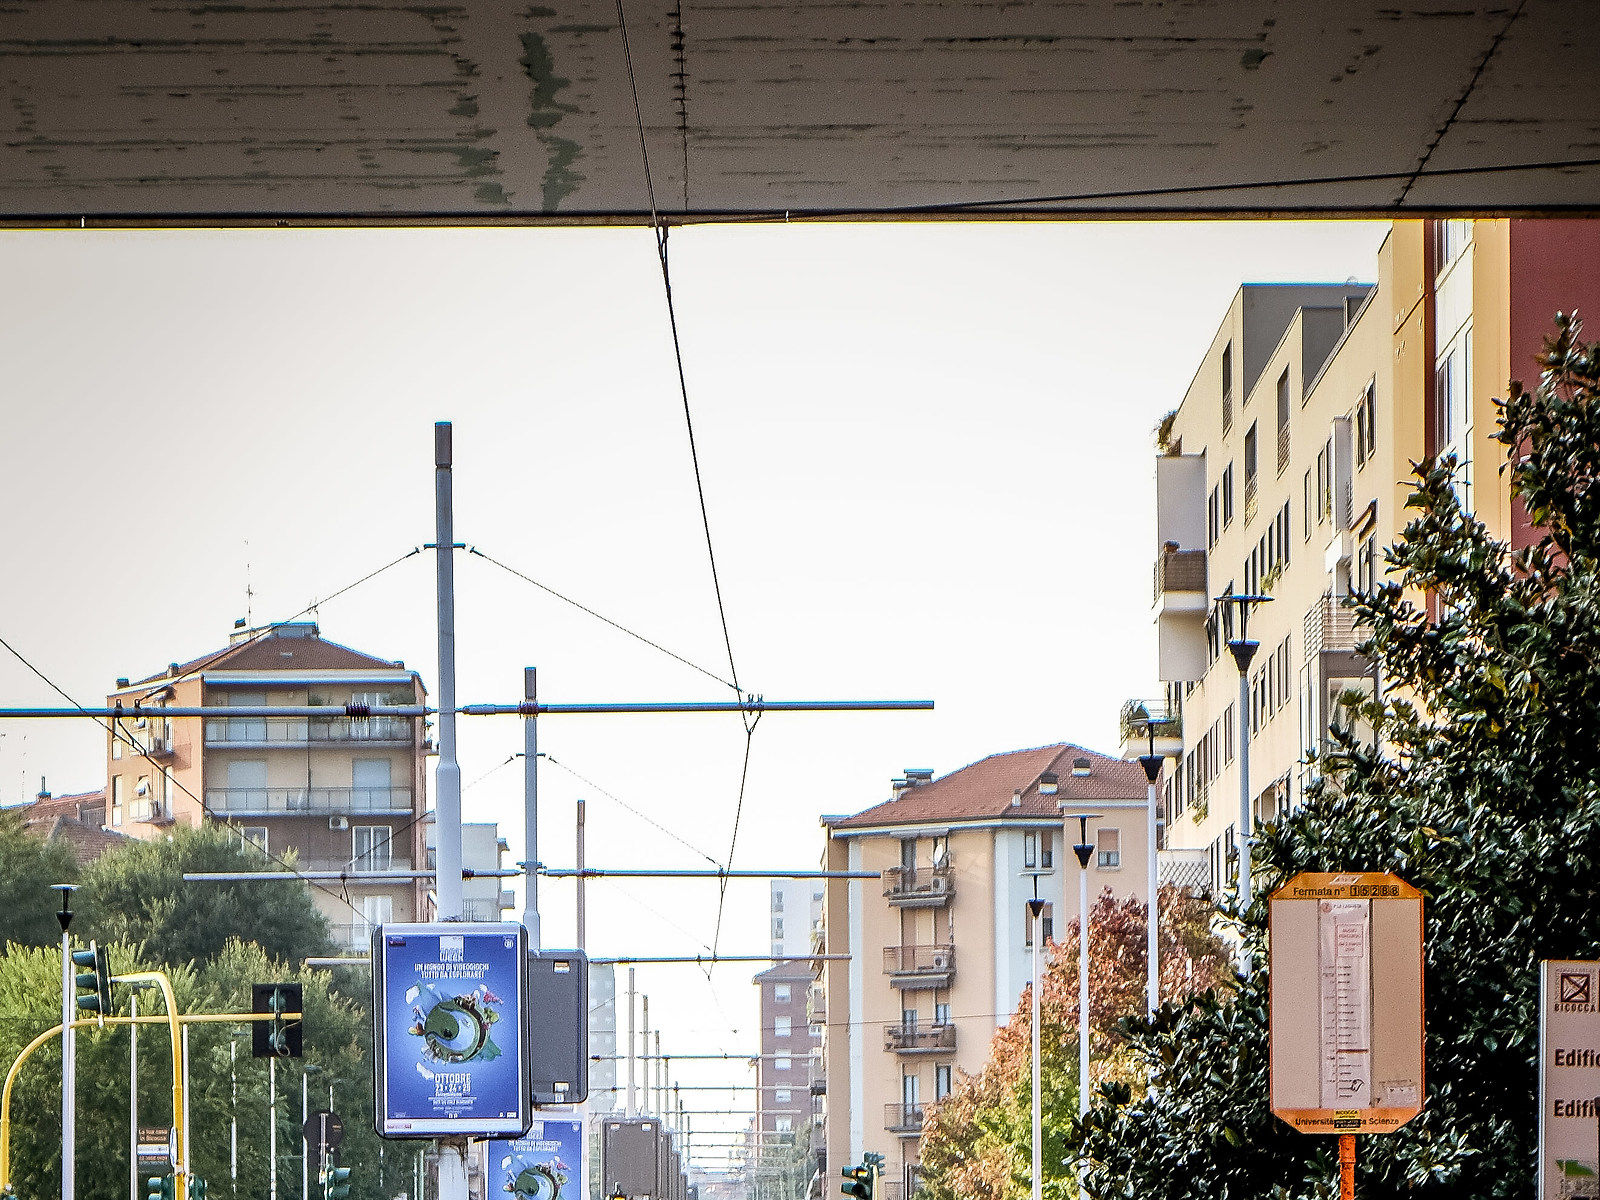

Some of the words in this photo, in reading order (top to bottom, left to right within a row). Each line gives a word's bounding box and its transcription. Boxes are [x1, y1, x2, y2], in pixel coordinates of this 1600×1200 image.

[1293, 887, 1332, 896] Fermata
[1554, 1003, 1596, 1012] BICOCCA
[435, 1073, 471, 1084] OTTOBRE
[1553, 1099, 1600, 1118] Edifi
[1295, 1117, 1334, 1126] Università
